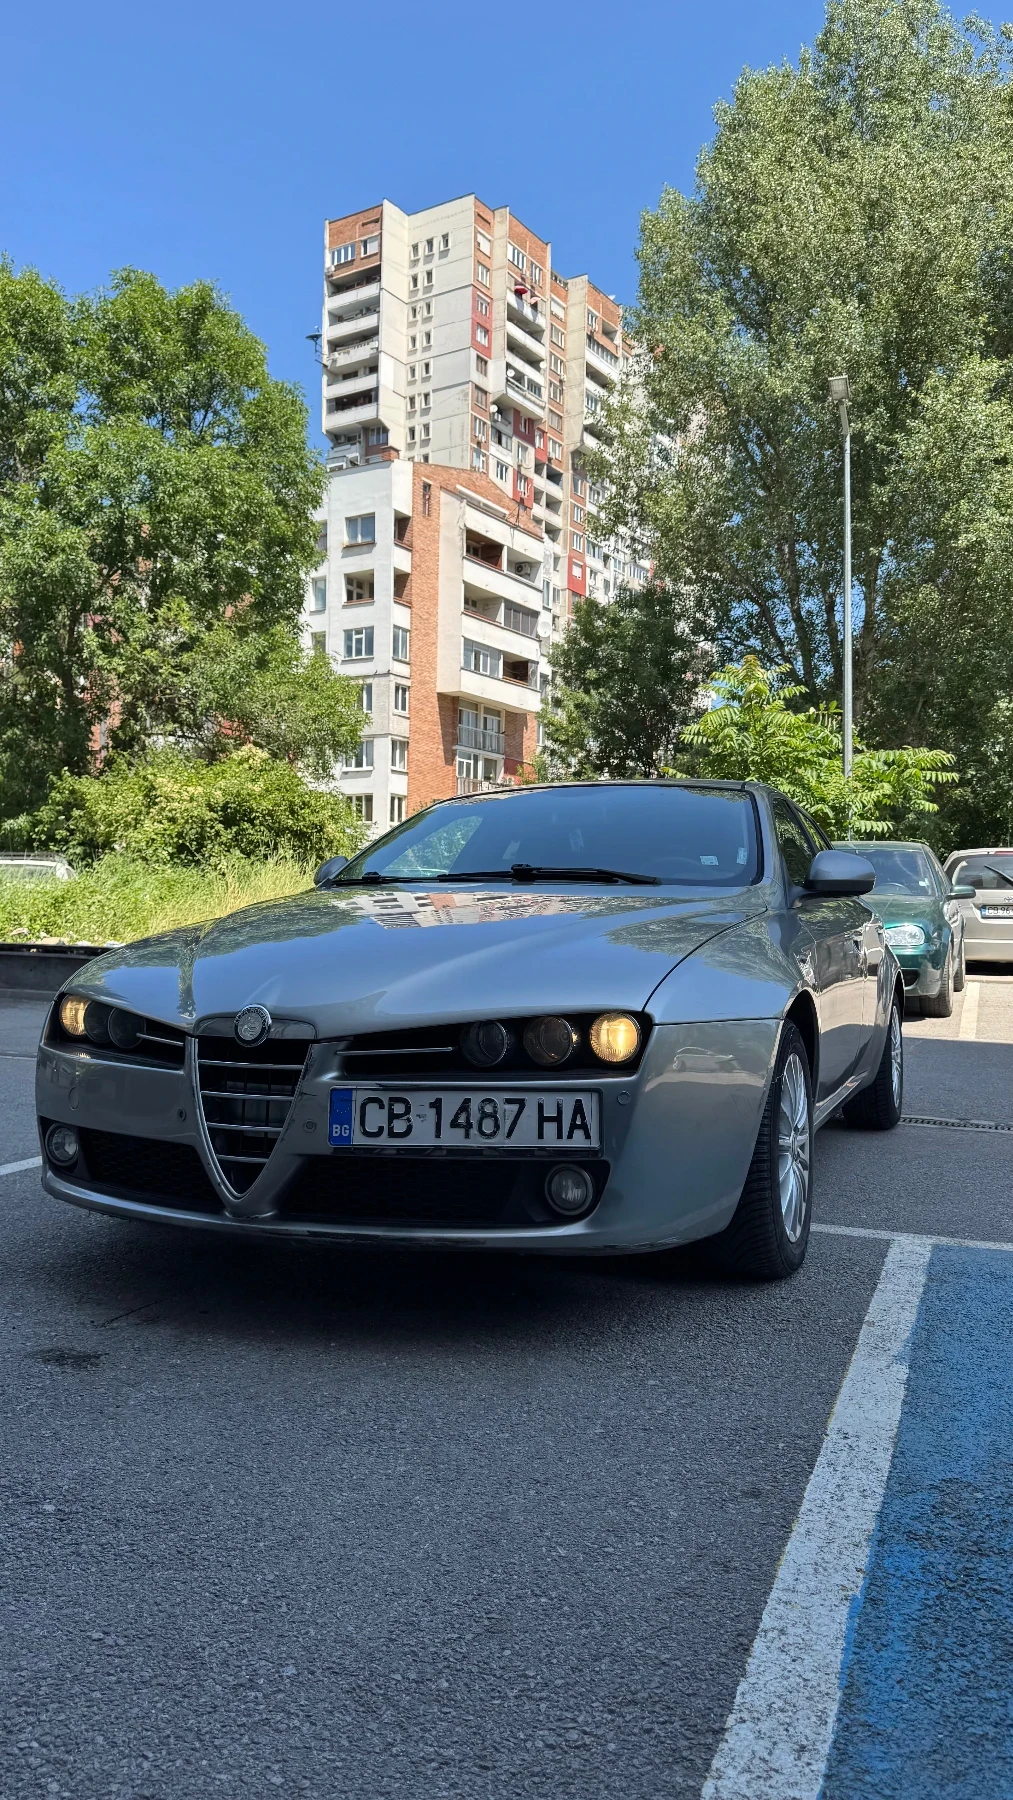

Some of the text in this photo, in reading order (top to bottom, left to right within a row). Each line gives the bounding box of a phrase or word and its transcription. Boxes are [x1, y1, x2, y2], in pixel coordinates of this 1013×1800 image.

[332, 1124, 350, 1137] BG
[359, 1096, 592, 1140] CB 1487 HA
